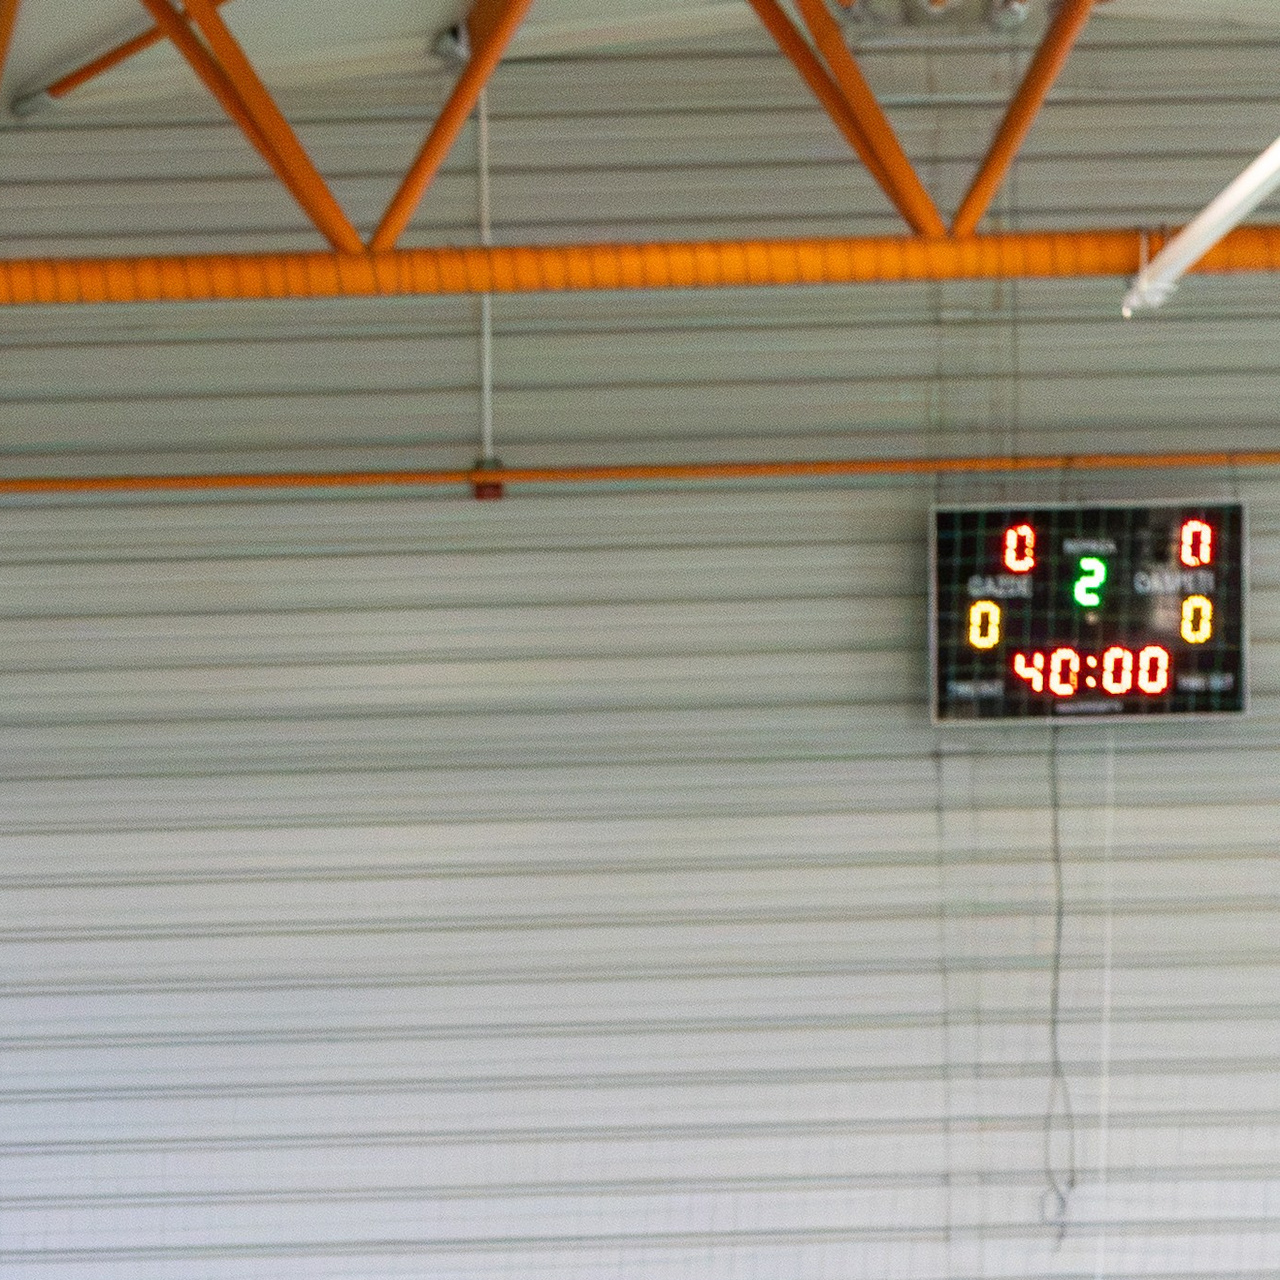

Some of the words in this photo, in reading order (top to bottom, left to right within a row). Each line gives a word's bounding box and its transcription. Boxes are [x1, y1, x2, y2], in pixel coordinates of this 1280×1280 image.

[1004, 524, 1035, 572] 0
[1180, 520, 1212, 567] 0
[1074, 557, 1107, 607] 2
[968, 600, 1001, 649] 0
[1180, 595, 1213, 643] 0
[1013, 645, 1169, 696] 40:00
